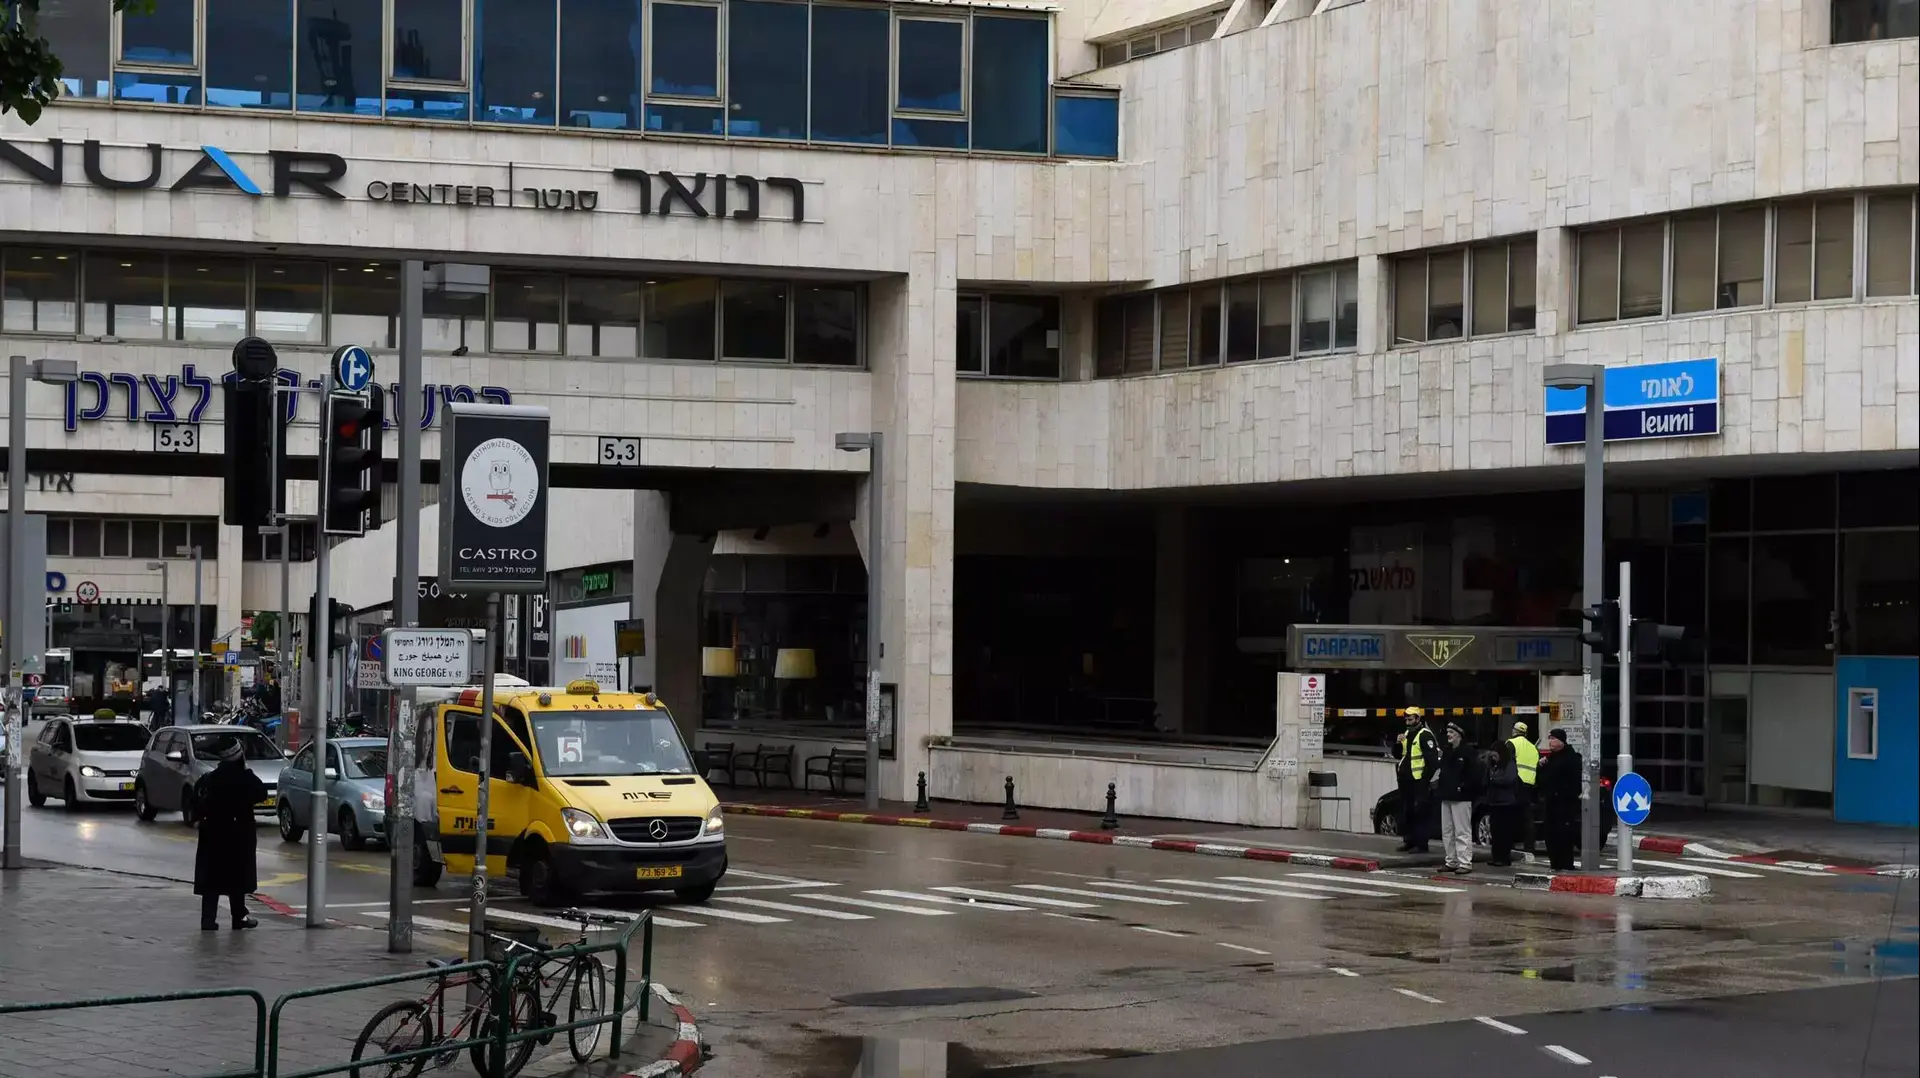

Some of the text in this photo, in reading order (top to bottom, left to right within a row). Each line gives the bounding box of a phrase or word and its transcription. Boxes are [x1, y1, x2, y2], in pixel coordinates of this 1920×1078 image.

[367, 180, 495, 206] CENTER
[523, 168, 805, 223] רנואר סנטר
[1640, 371, 1694, 399] לאומי
[63, 364, 213, 433] לצרכן
[1640, 407, 1694, 433] leumi
[160, 429, 194, 448] 5.3
[471, 440, 530, 463] AUTHORIZED STORE
[604, 443, 637, 461] 5.3
[487, 515, 503, 524] KIDS
[505, 488, 536, 523] COLLECTION
[459, 548, 537, 560] CASTRO
[436, 635, 455, 649] המלך
[1306, 636, 1380, 657] CARPARK
[1432, 640, 1449, 660] 1.75
[393, 668, 413, 678] KING
[415, 668, 447, 678] GEORGE
[563, 738, 580, 762] 5
